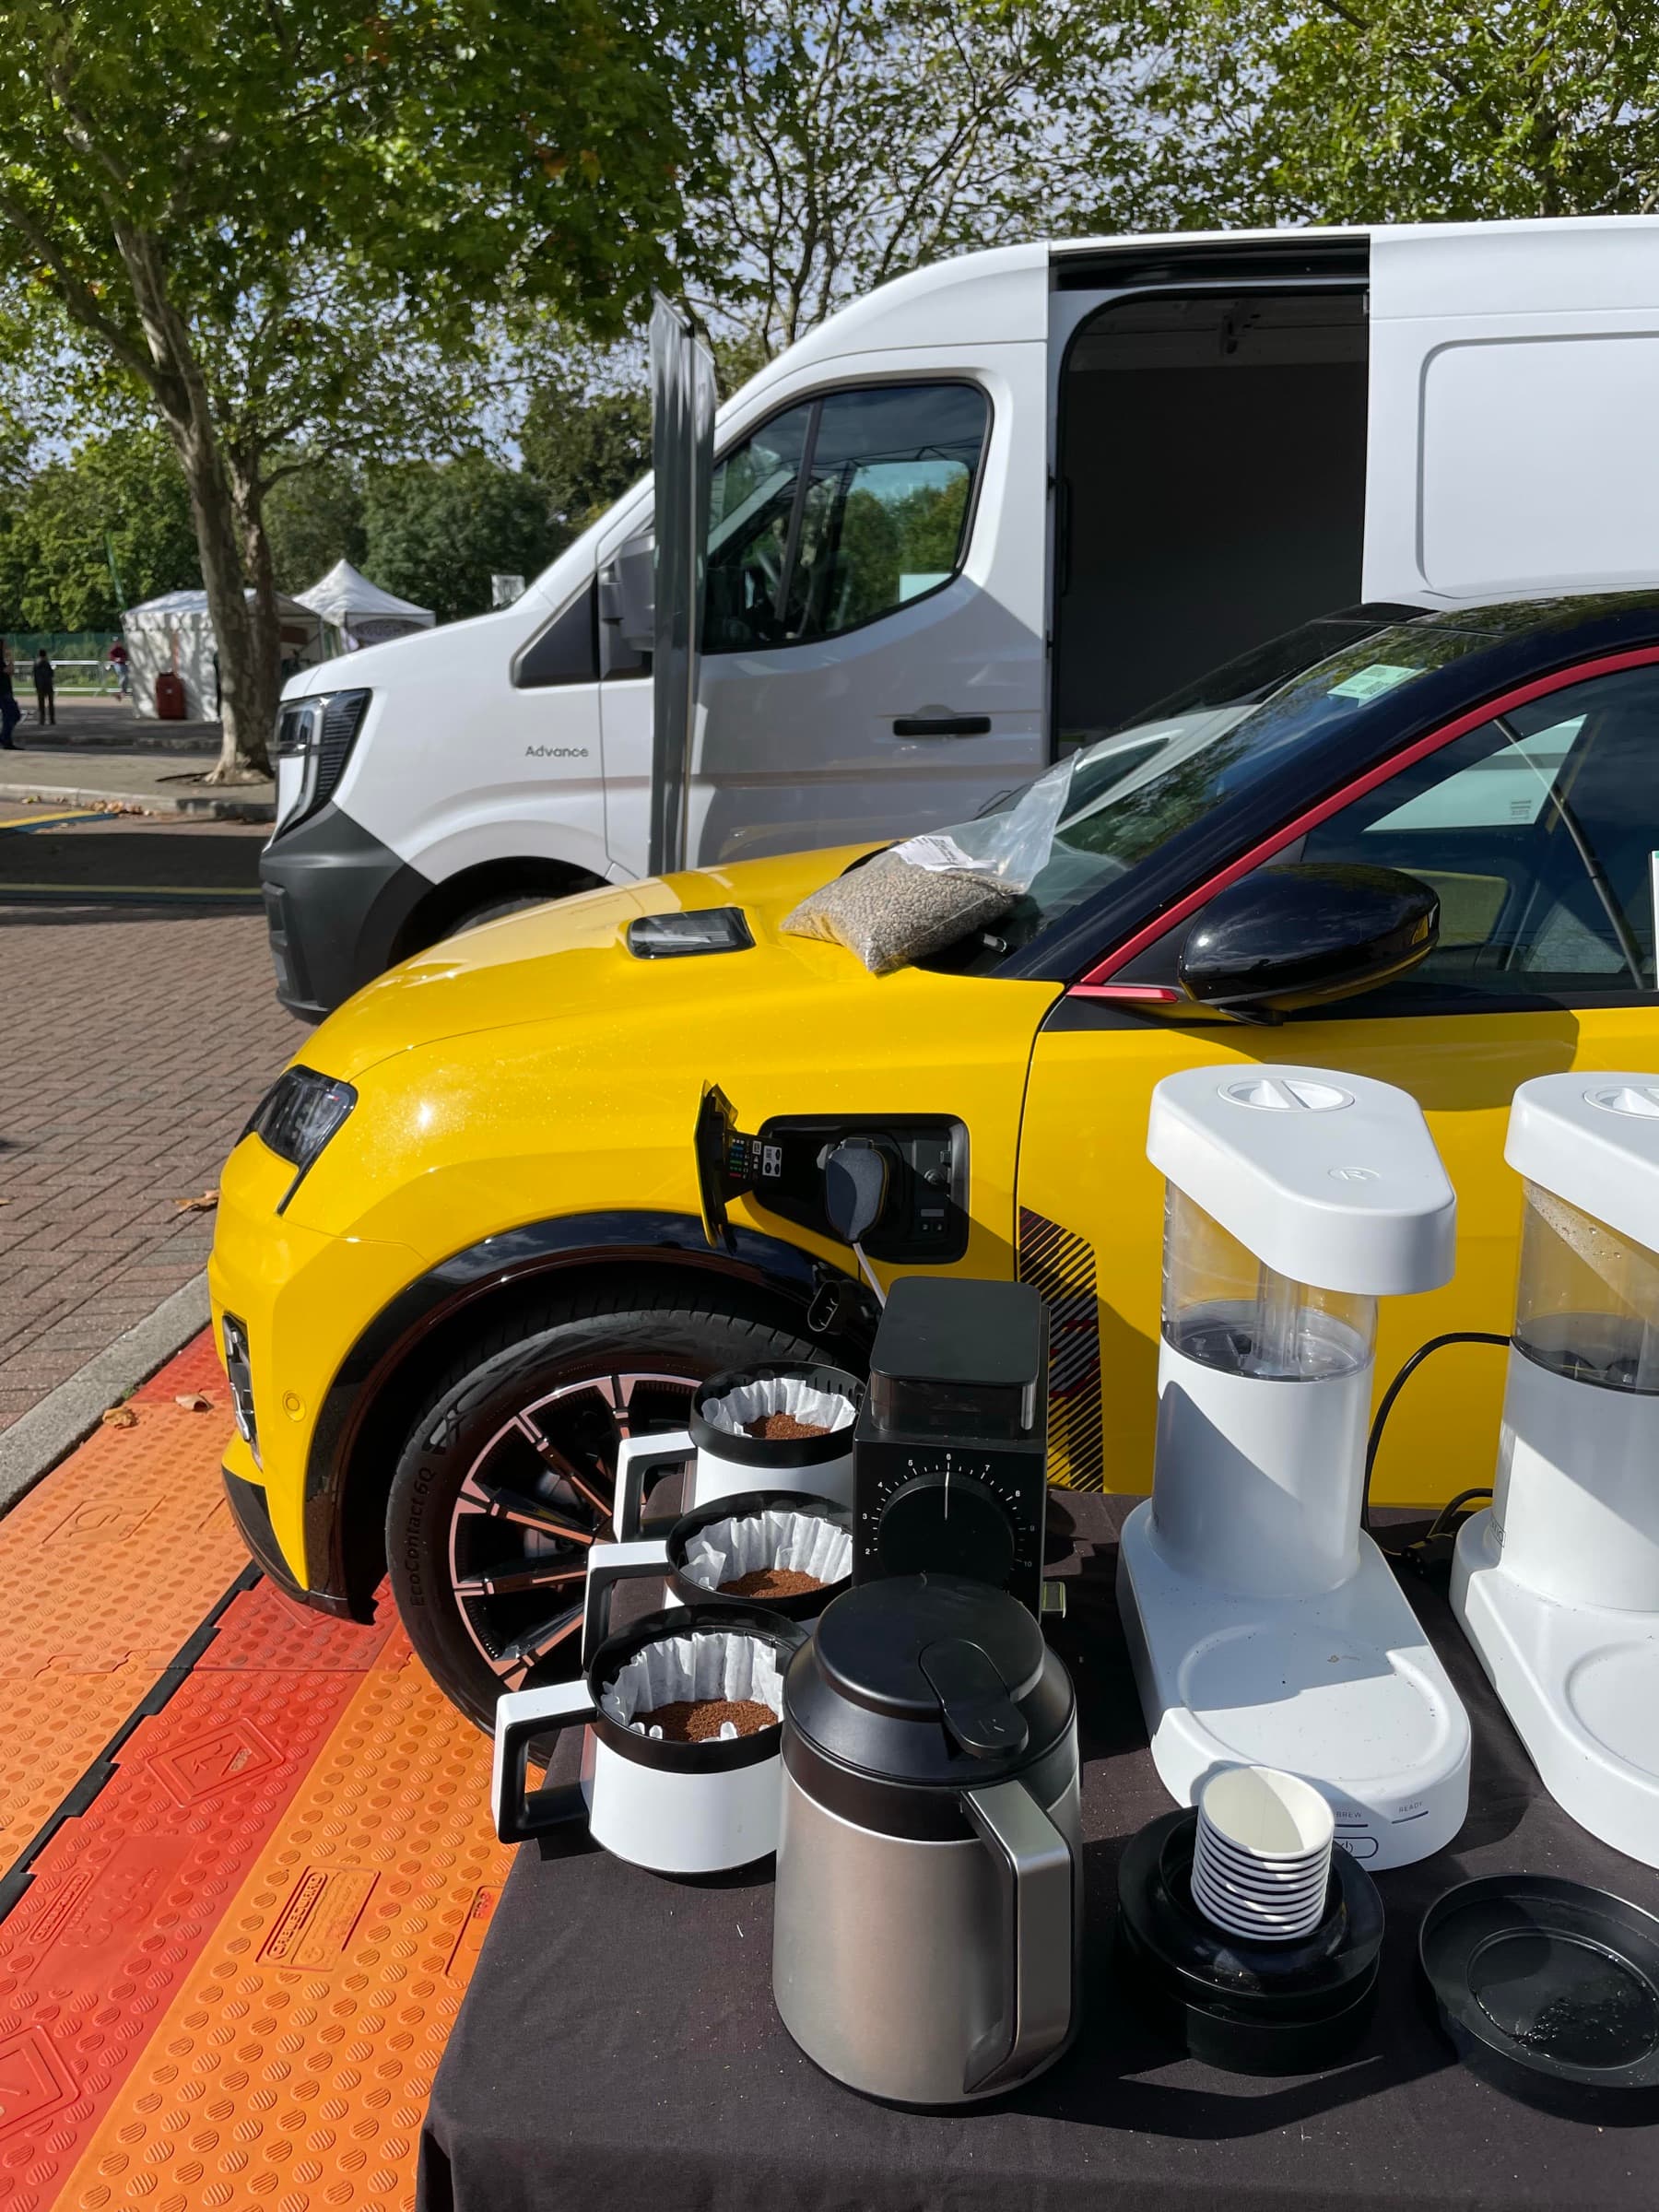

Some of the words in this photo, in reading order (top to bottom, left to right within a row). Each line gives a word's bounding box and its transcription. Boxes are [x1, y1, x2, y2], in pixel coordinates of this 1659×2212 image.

[525, 746, 589, 758] Advance
[405, 1498, 425, 1606] EcoContact
[1398, 1801, 1423, 1813] READY
